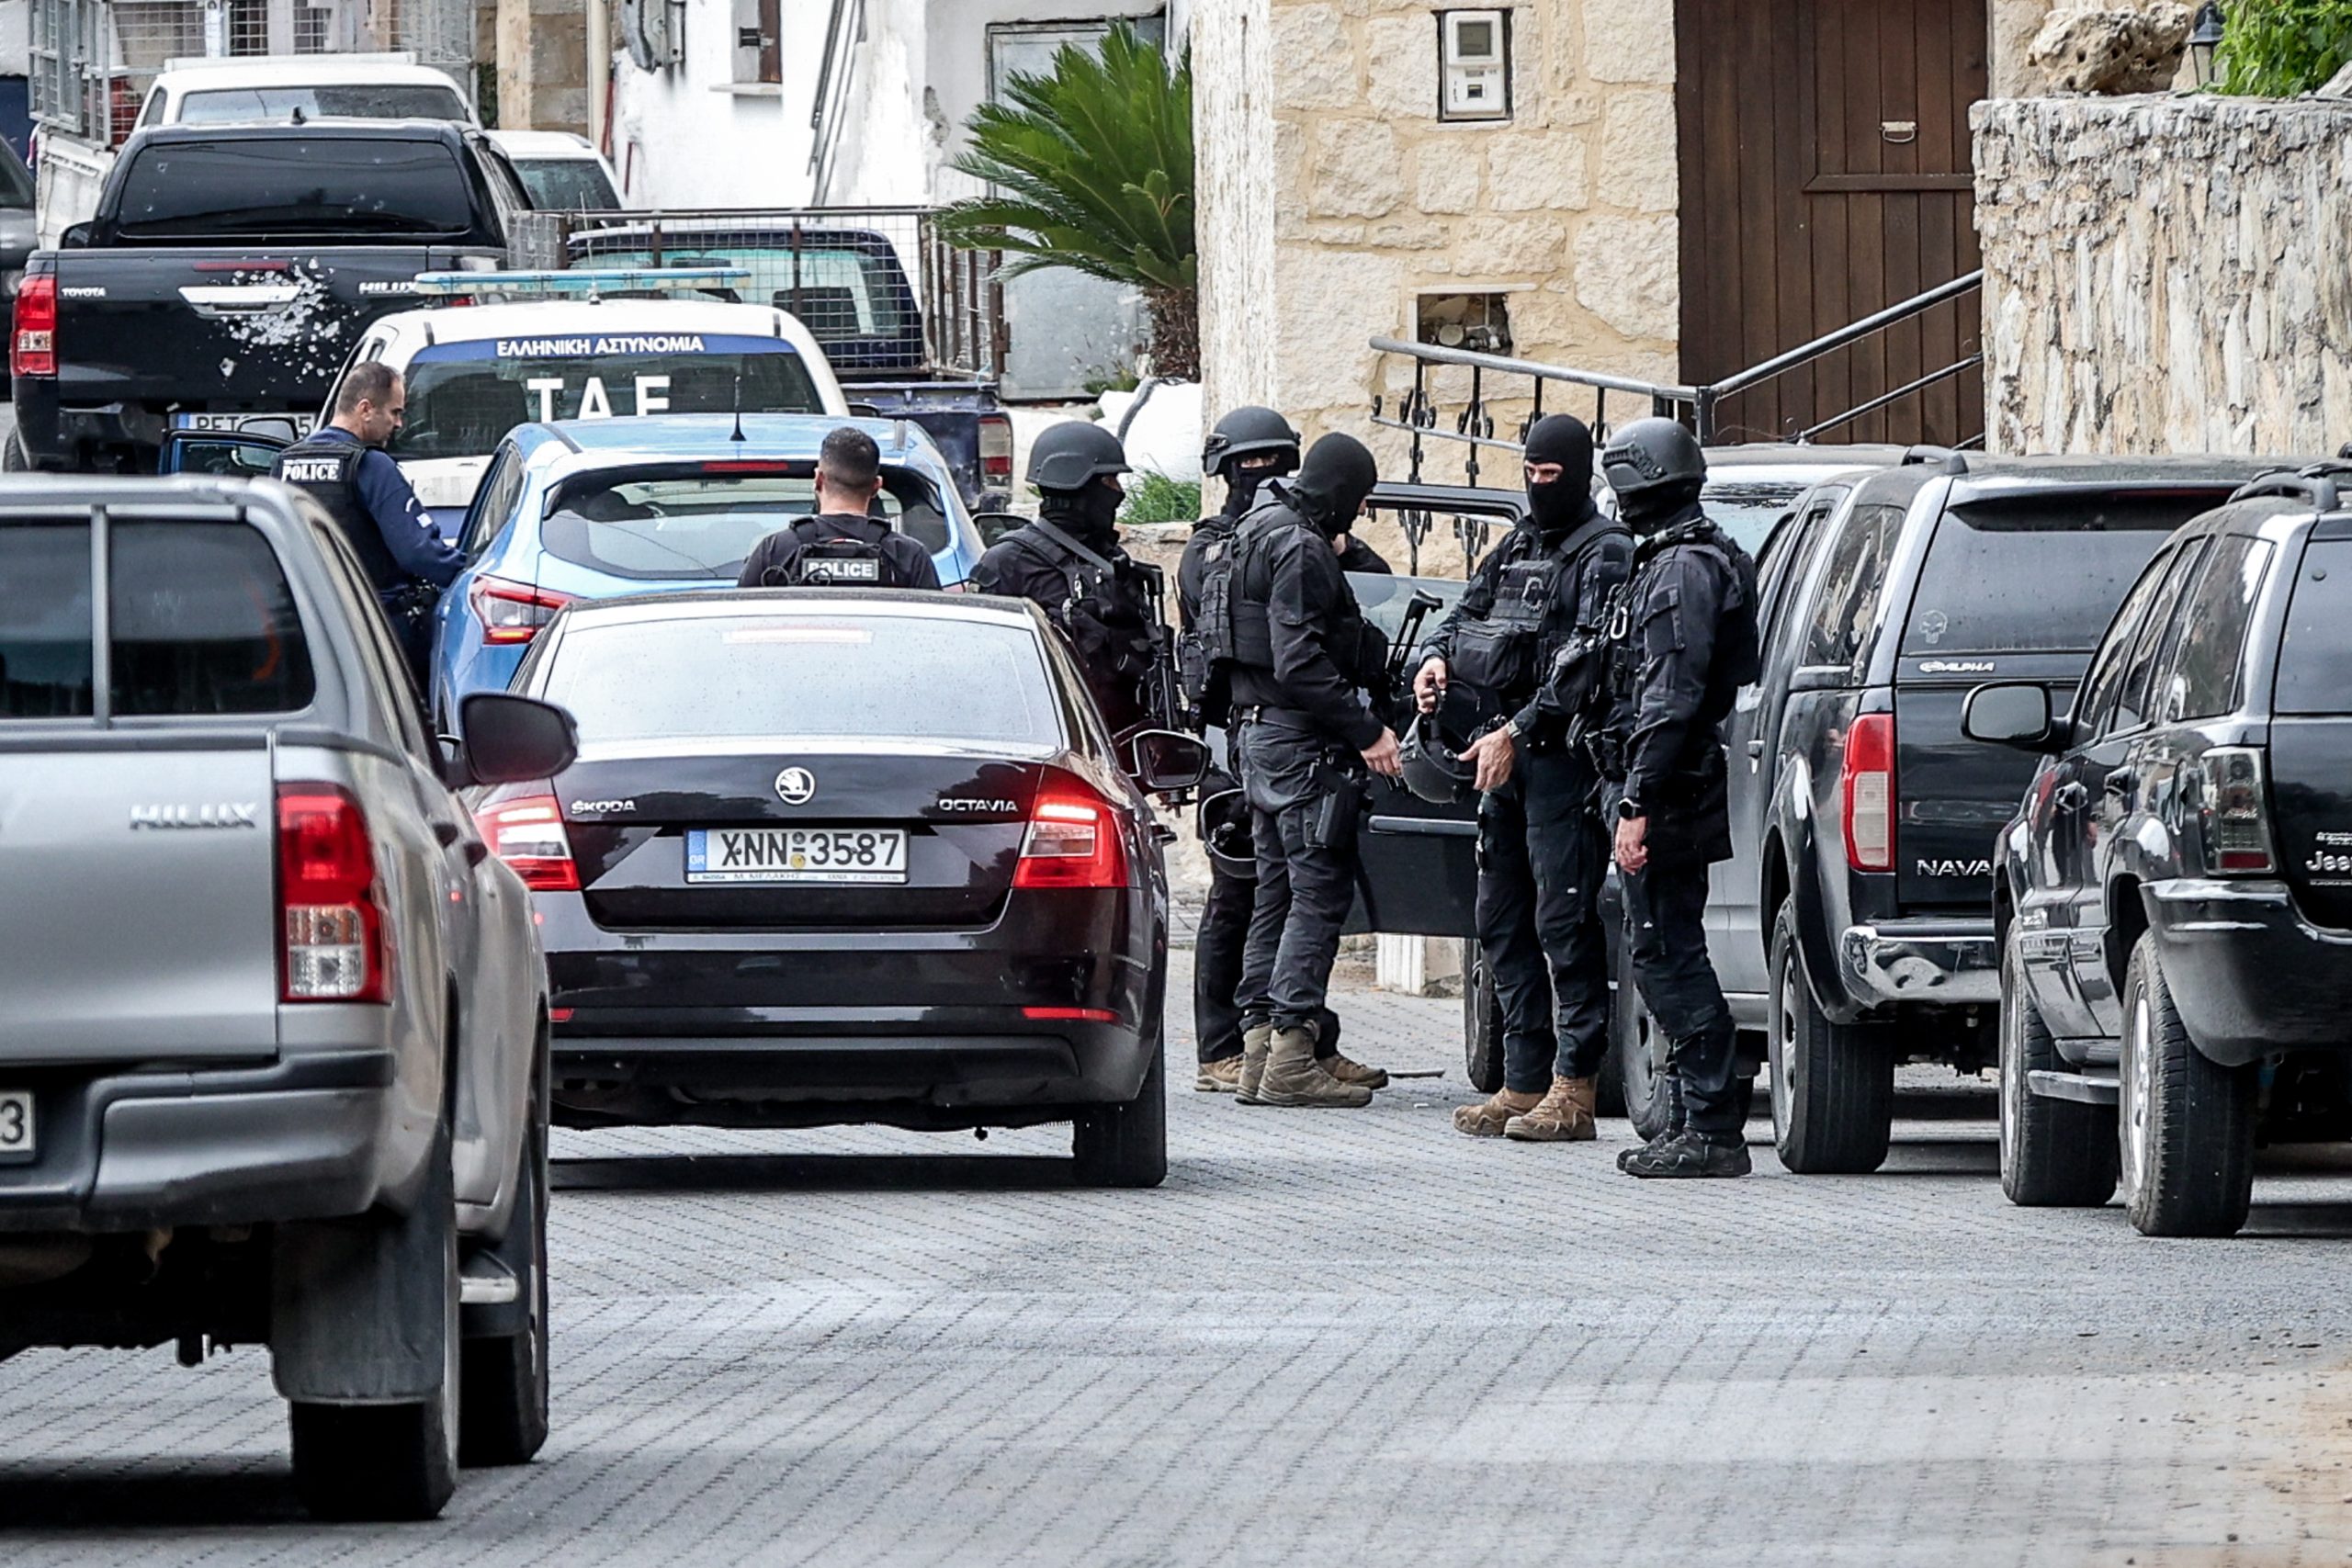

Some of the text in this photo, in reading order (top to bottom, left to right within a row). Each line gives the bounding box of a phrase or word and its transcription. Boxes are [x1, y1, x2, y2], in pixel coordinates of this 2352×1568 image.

[62, 288, 106, 297] TOYOTA
[496, 335, 706, 356] ΕΛΛΗΝΙΚΗ ΑΣΤΥΝΟΜΙΑ
[281, 464, 340, 482] POLICE
[808, 561, 874, 578] POLICE
[939, 798, 1019, 812] OCTAVIA
[130, 803, 256, 829] HILUX
[1917, 860, 1995, 876] NAVA
[2305, 851, 2352, 874] Jee
[0, 1099, 24, 1144] 3
